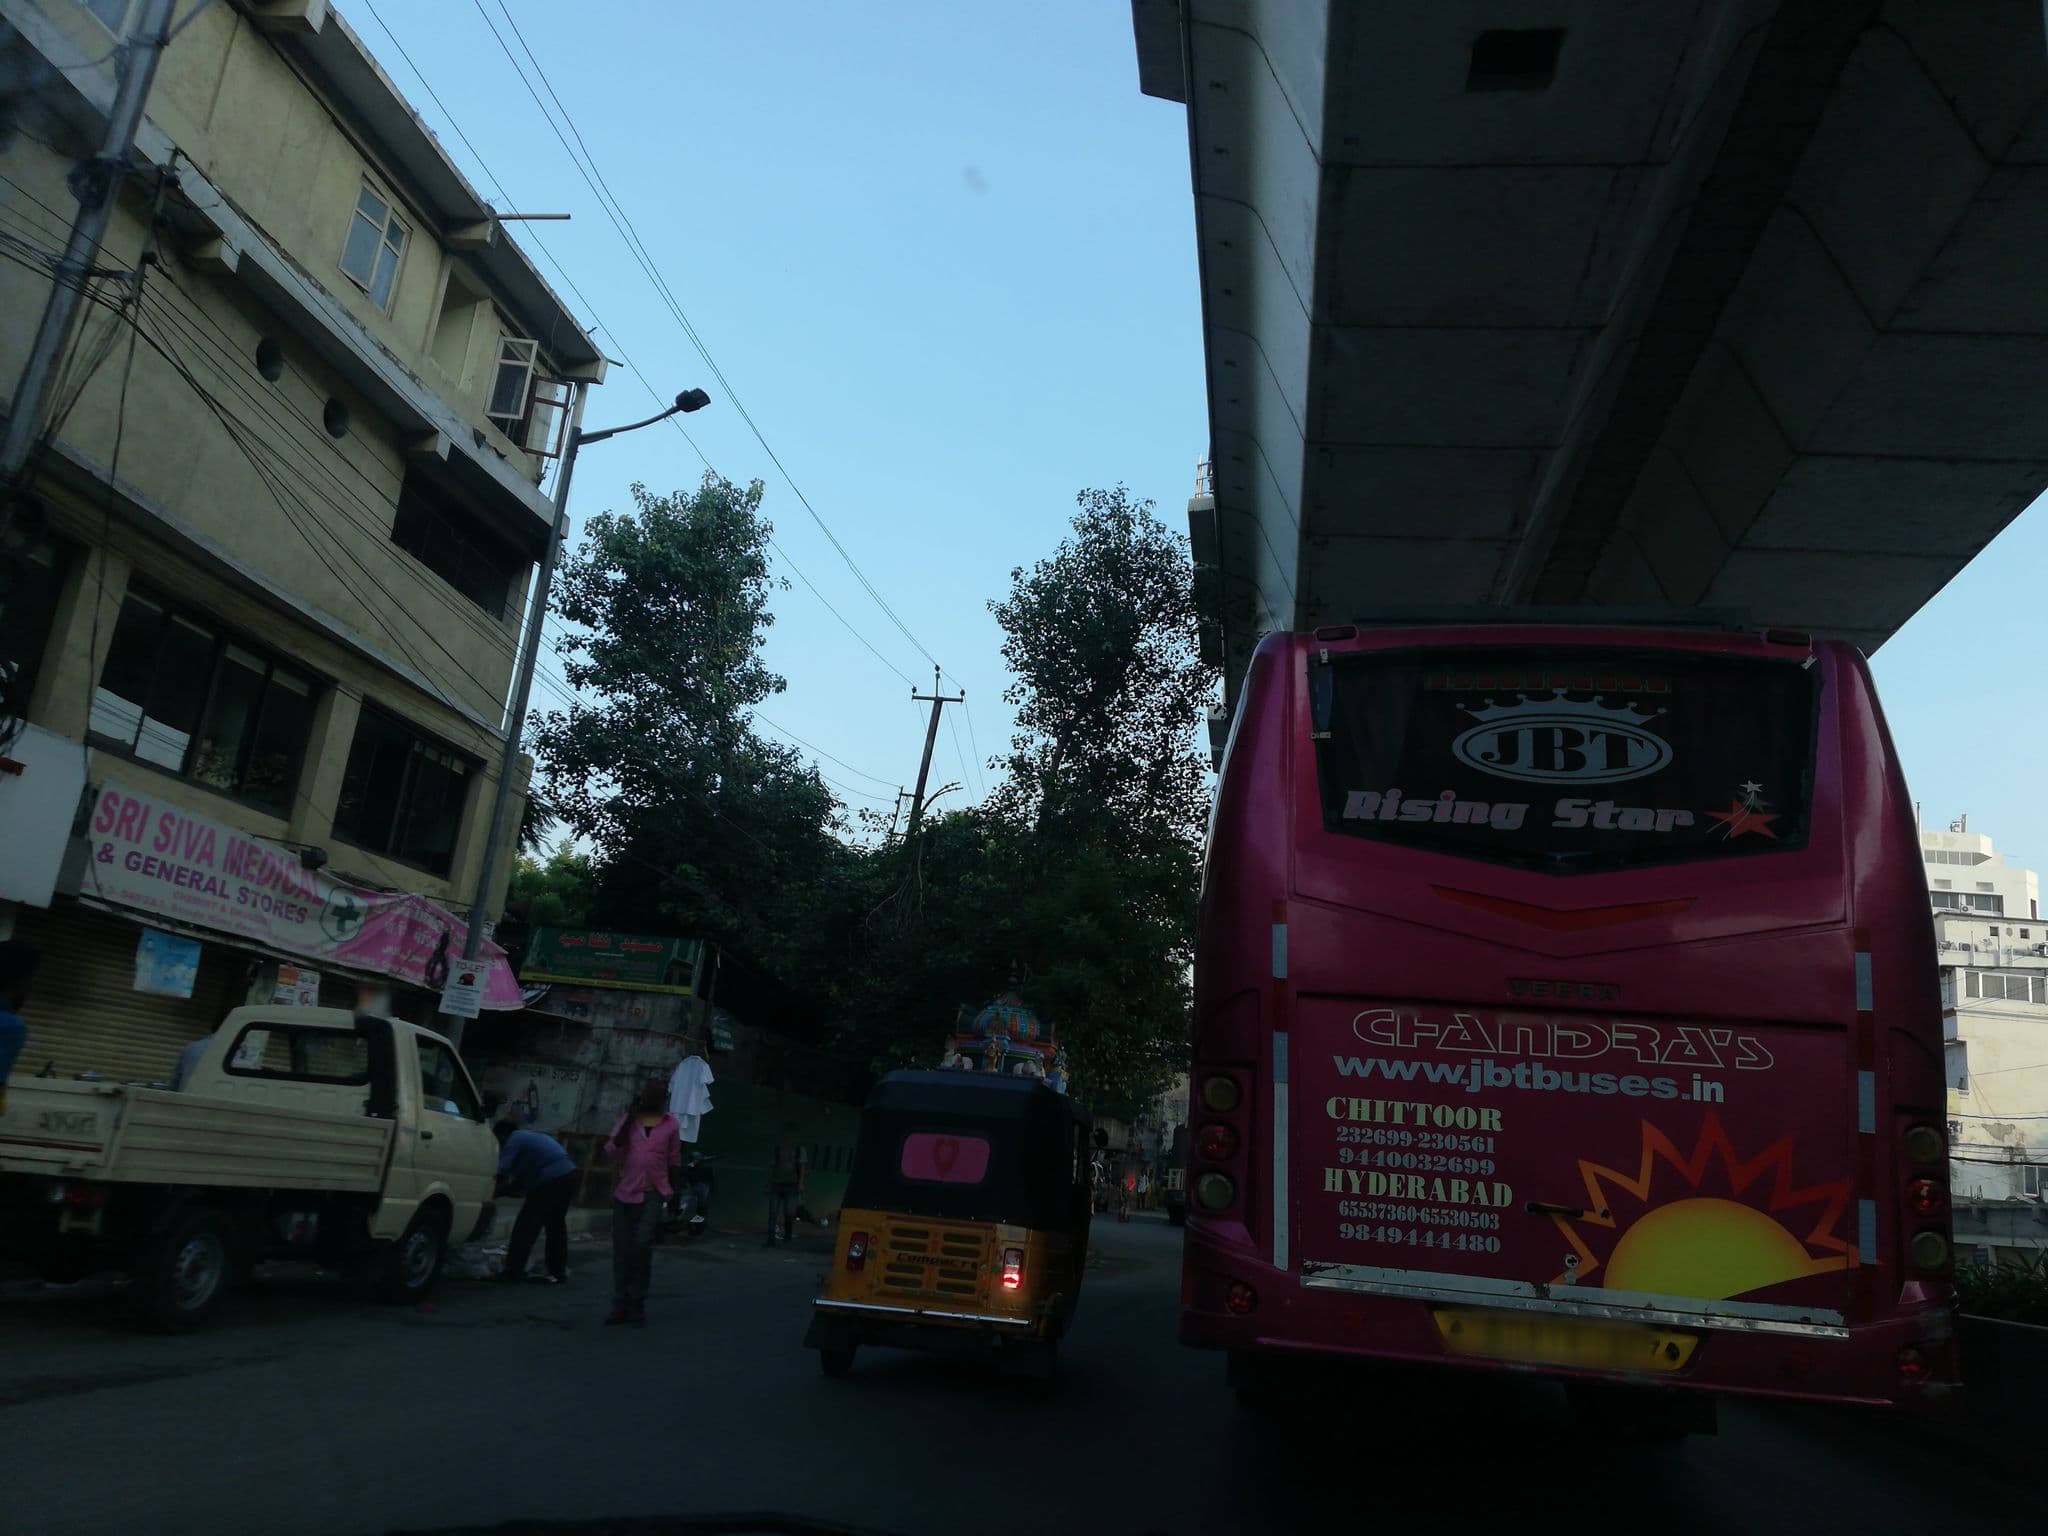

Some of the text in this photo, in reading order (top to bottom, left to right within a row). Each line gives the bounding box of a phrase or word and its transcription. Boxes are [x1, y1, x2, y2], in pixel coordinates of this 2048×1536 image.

[1480, 727, 1645, 771] JBT
[95, 790, 151, 845] SRI
[153, 811, 216, 868] SIVA
[1341, 787, 1697, 834] Rising Star
[97, 842, 115, 864] &
[124, 850, 230, 900] GENERAL
[236, 886, 309, 924] STORES
[1352, 1008, 1776, 1071] CHANDRA'S
[1332, 1055, 1725, 1103] www.jbtbuses.in
[1325, 1096, 1505, 1132] CHITTOOR
[1336, 1126, 1496, 1154] 232699-230561
[1338, 1147, 1496, 1176] 9440032699
[1323, 1167, 1515, 1208] HYDERABAD
[1338, 1222, 1502, 1254] 9849444480
